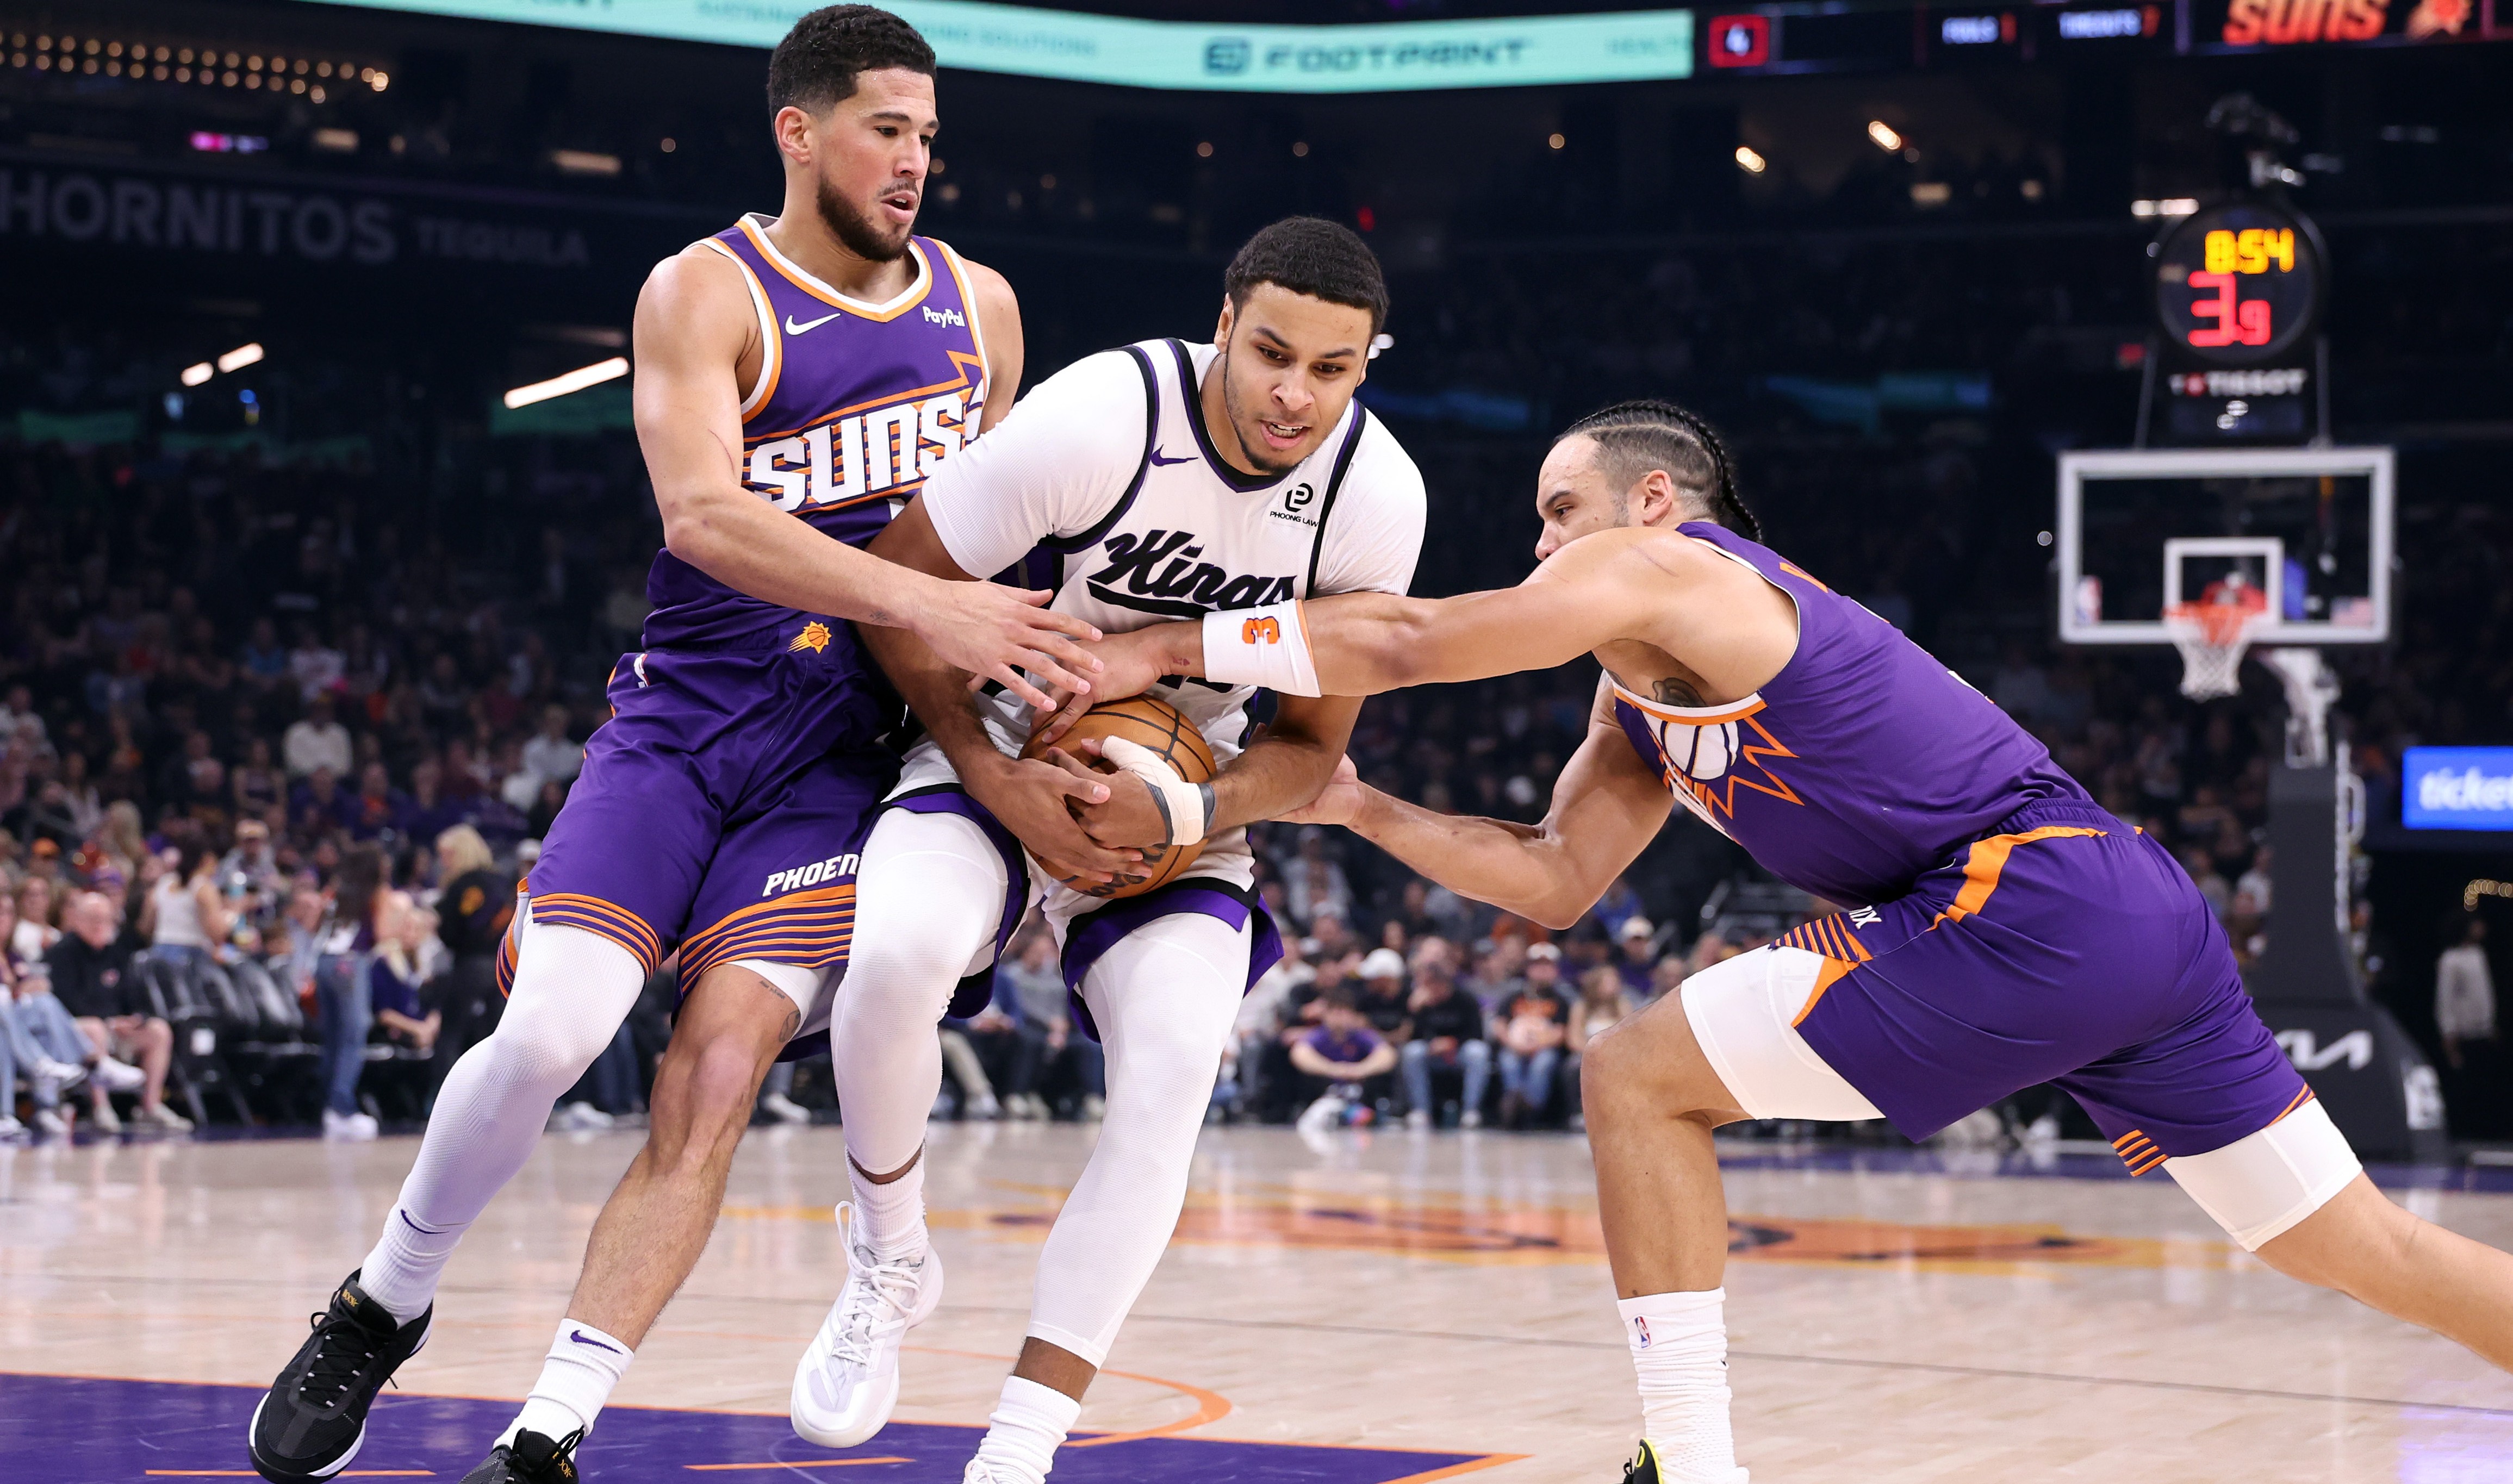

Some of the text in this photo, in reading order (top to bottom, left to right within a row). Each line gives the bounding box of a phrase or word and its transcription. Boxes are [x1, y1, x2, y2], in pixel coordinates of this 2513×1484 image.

[1264, 38, 1527, 72] FOOTPRINT
[0, 167, 589, 267] HORNITOS TEQUILA
[922, 305, 966, 328] PayPal
[750, 393, 964, 513] SUNS
[1270, 511, 1318, 527] PHOONG LAW
[1087, 529, 1298, 610] Kings
[1242, 615, 1280, 644] 3
[2419, 766, 2513, 811] ticke
